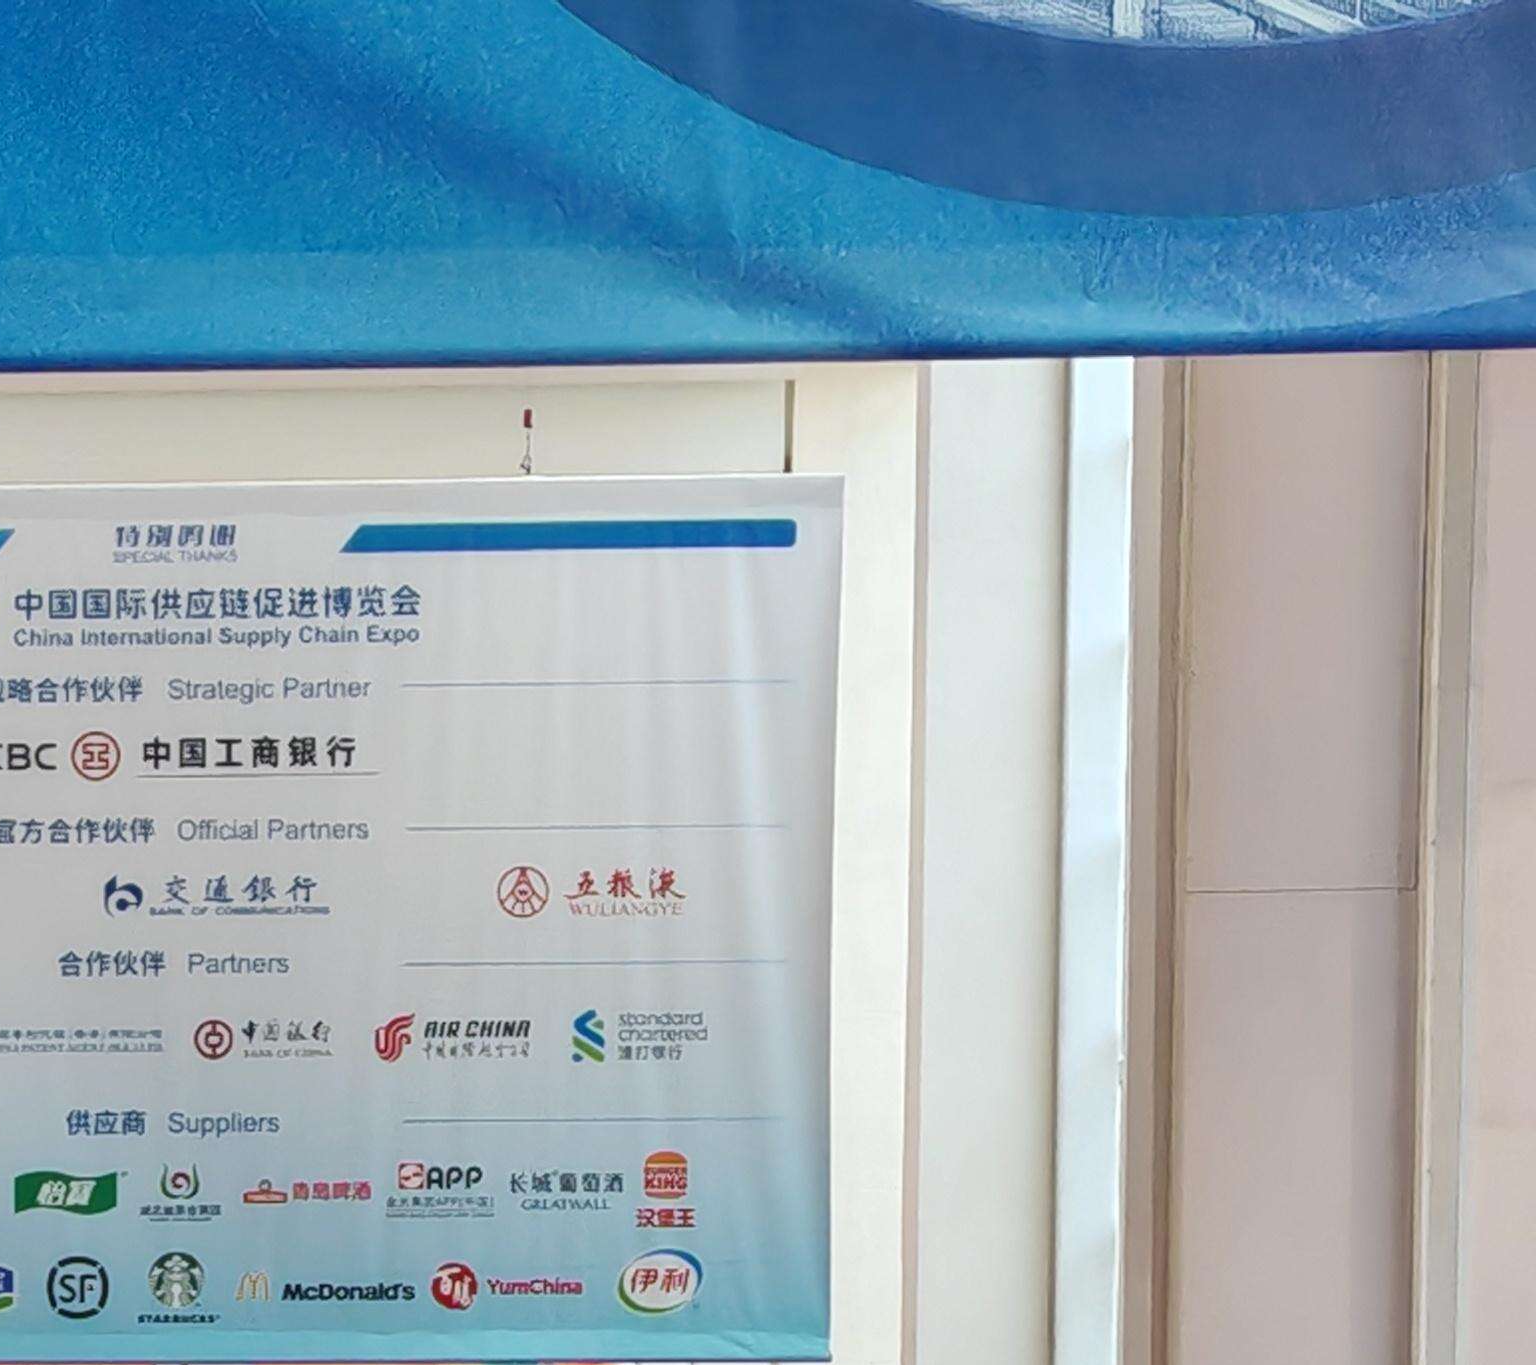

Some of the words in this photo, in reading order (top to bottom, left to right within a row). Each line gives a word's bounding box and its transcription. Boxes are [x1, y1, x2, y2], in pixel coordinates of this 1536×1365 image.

[178, 549, 239, 563] THANKS
[13, 584, 422, 621] 中国国际供应链促进博览会
[13, 626, 74, 648] China
[80, 625, 212, 647] International
[218, 625, 291, 652] Supply
[297, 624, 360, 645] Chain
[366, 624, 421, 648] Expo
[167, 677, 274, 705] Strategic
[282, 676, 372, 699] Partner
[142, 735, 357, 769] 中国工商银行
[176, 817, 259, 842] Official
[267, 818, 369, 842] Partners
[58, 951, 166, 977] 合作伙伴
[187, 953, 290, 975] Partners
[424, 1020, 460, 1038] AIR
[465, 1020, 531, 1038] CHINA
[66, 1109, 147, 1136] 供应商
[167, 1112, 281, 1138] Suppliers
[426, 1166, 484, 1189] APP
[636, 1208, 697, 1228] 汉堡王
[58, 1275, 97, 1303] SF
[281, 1282, 416, 1302] McDonald's
[630, 1267, 691, 1294] 伊利
